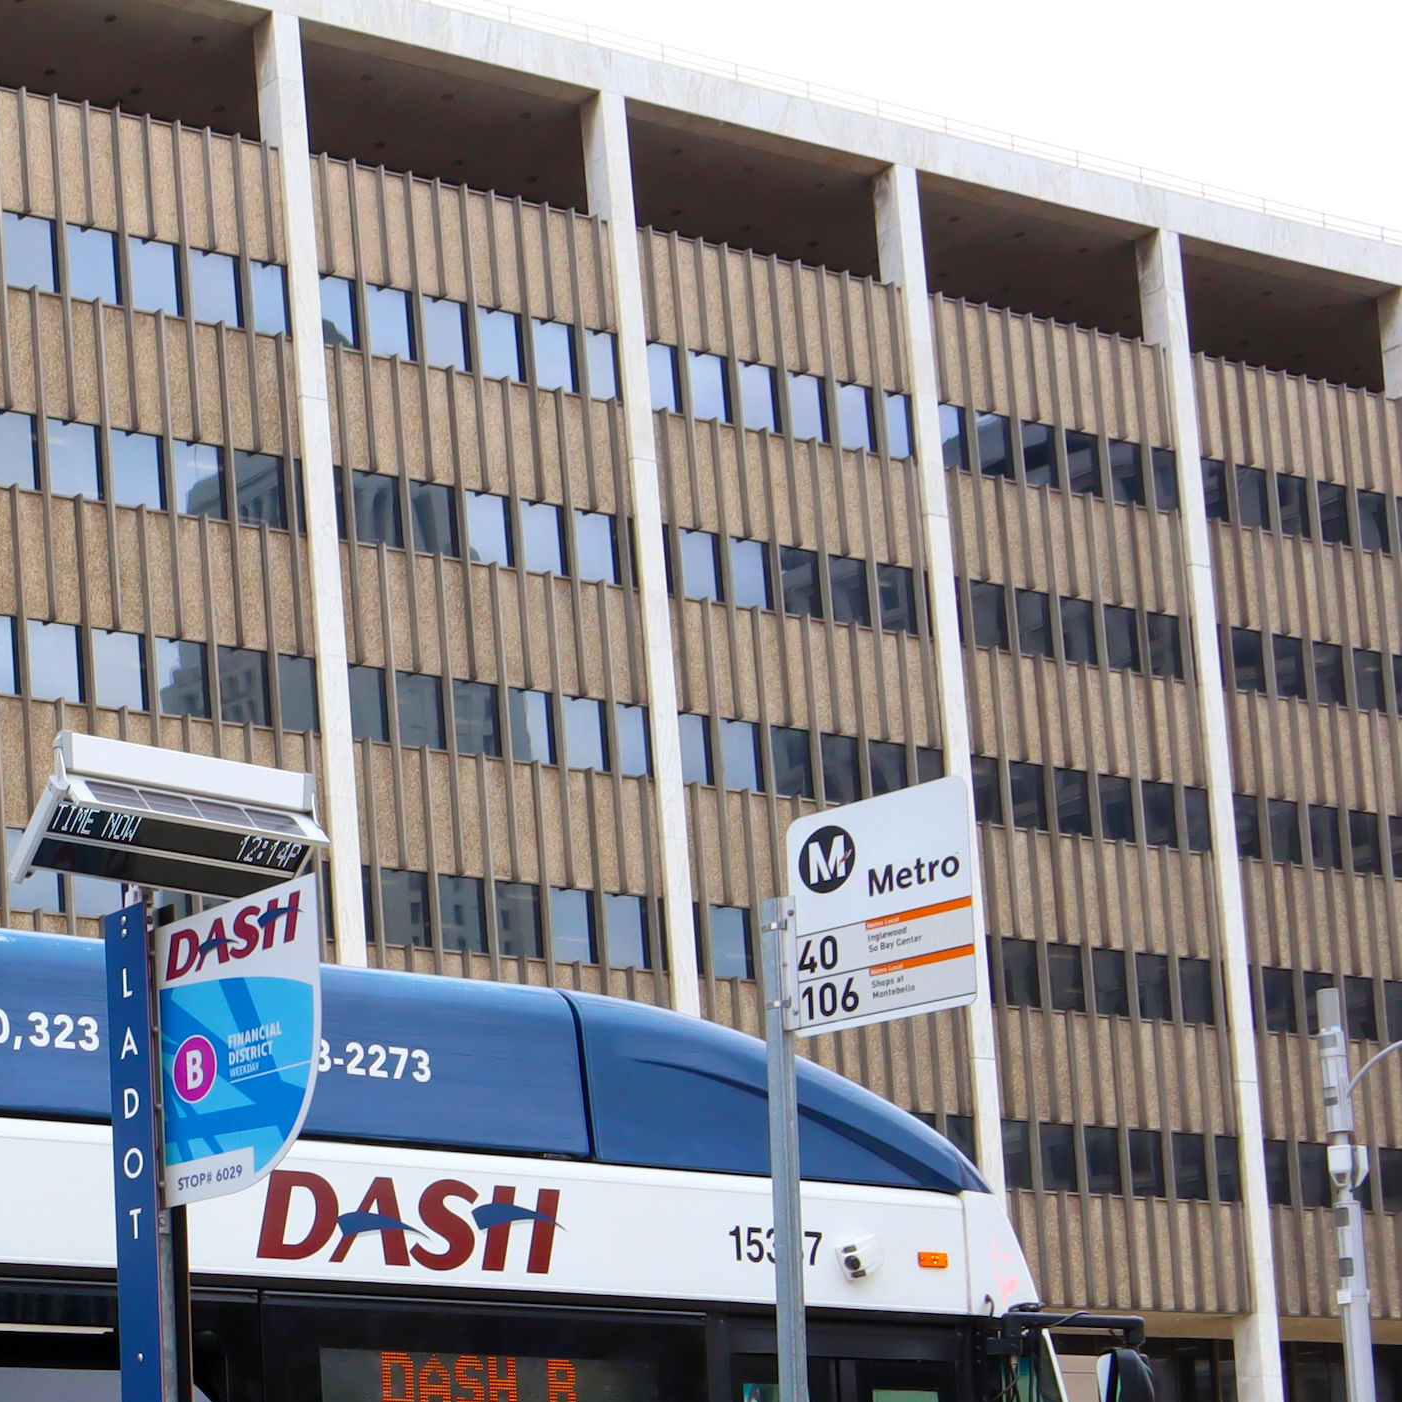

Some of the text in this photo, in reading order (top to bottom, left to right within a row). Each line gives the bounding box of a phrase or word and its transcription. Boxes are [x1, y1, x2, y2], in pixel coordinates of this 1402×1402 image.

[51, 803, 303, 869] TIME NOW 12:14P
[868, 854, 960, 897] Metro
[166, 890, 302, 982] DASH
[867, 926, 907, 942] Inglewood
[880, 941, 894, 951] Bay
[896, 935, 923, 947] Center
[798, 935, 838, 974] 40
[802, 977, 860, 1021] 106
[227, 1021, 283, 1048] FINANCIAL
[228, 1041, 274, 1066] DISTRICT
[186, 1050, 204, 1091] B
[229, 1062, 260, 1078] WEEKDAY
[177, 1166, 243, 1191] STOP# 6029
[256, 1168, 563, 1274] DASH
